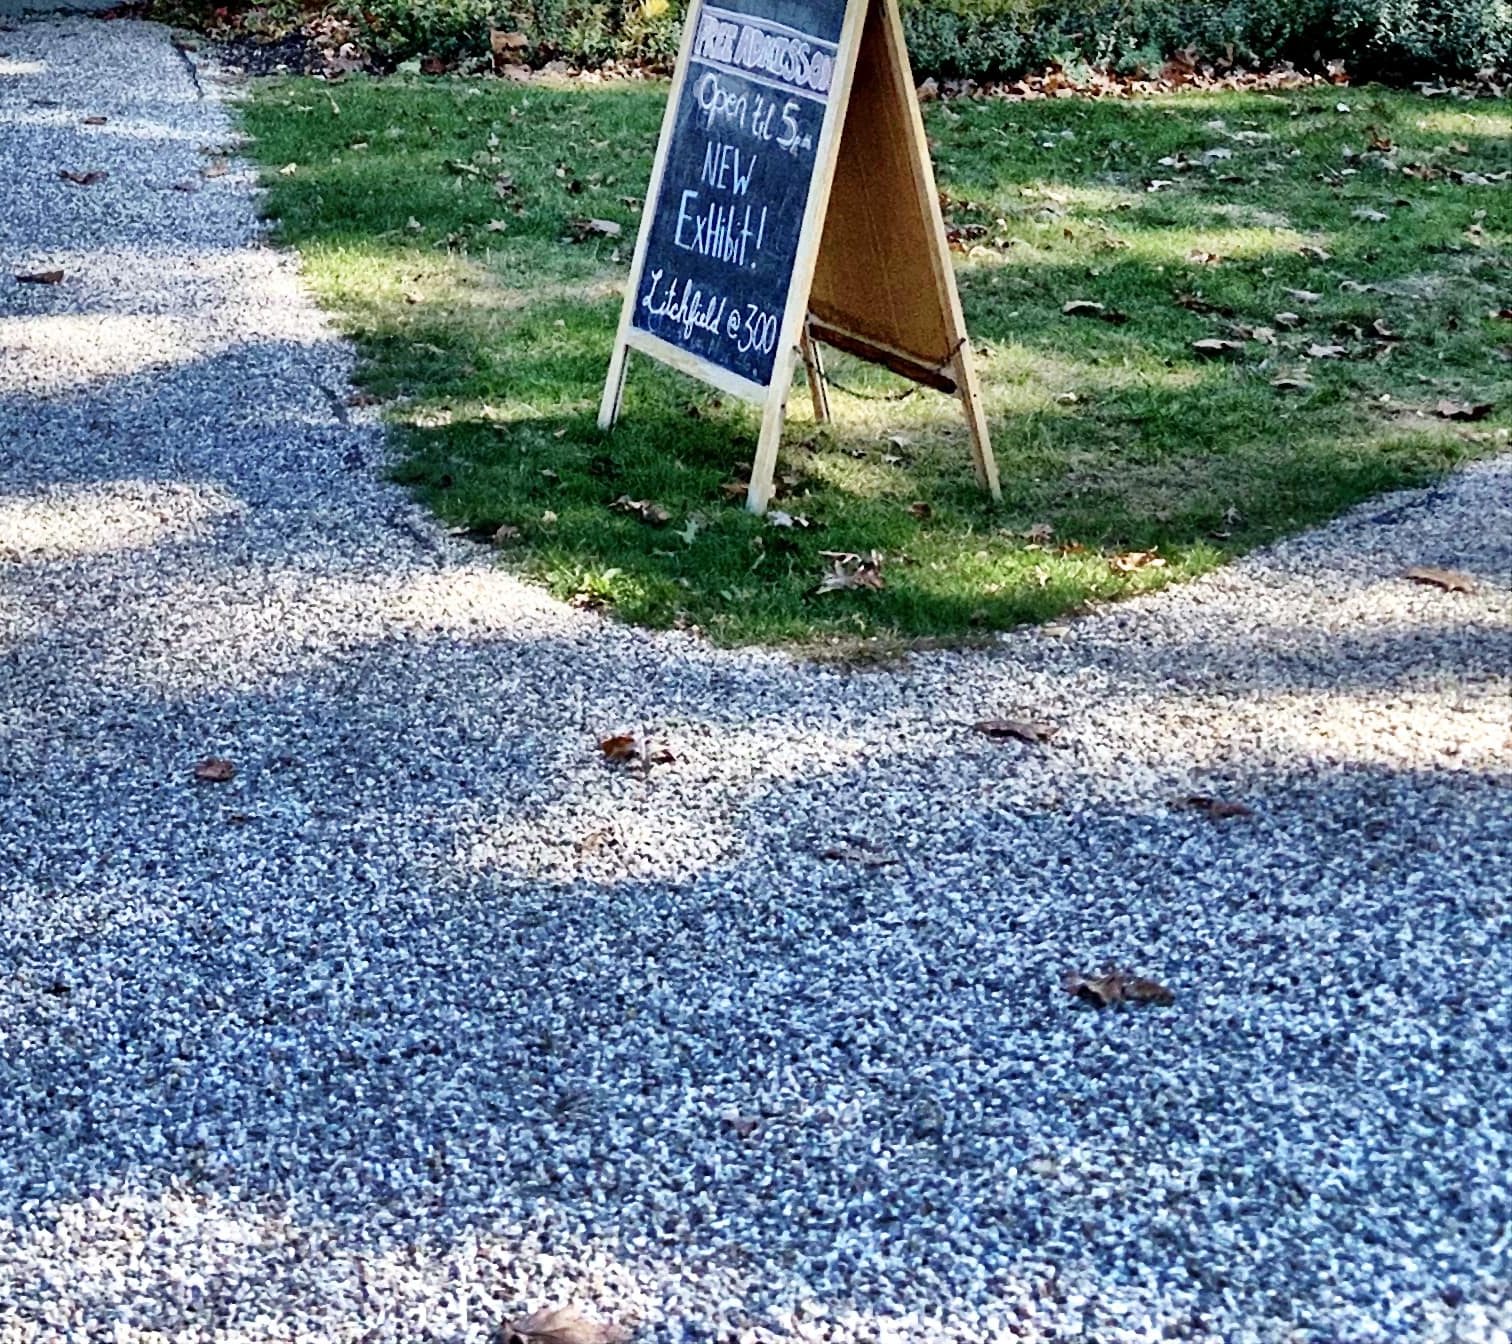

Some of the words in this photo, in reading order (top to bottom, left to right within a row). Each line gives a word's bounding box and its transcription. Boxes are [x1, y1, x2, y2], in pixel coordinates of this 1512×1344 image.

[694, 13, 739, 63] FREE
[699, 72, 748, 132] Open
[700, 140, 758, 196] NEW
[642, 268, 728, 340] Litchfield
